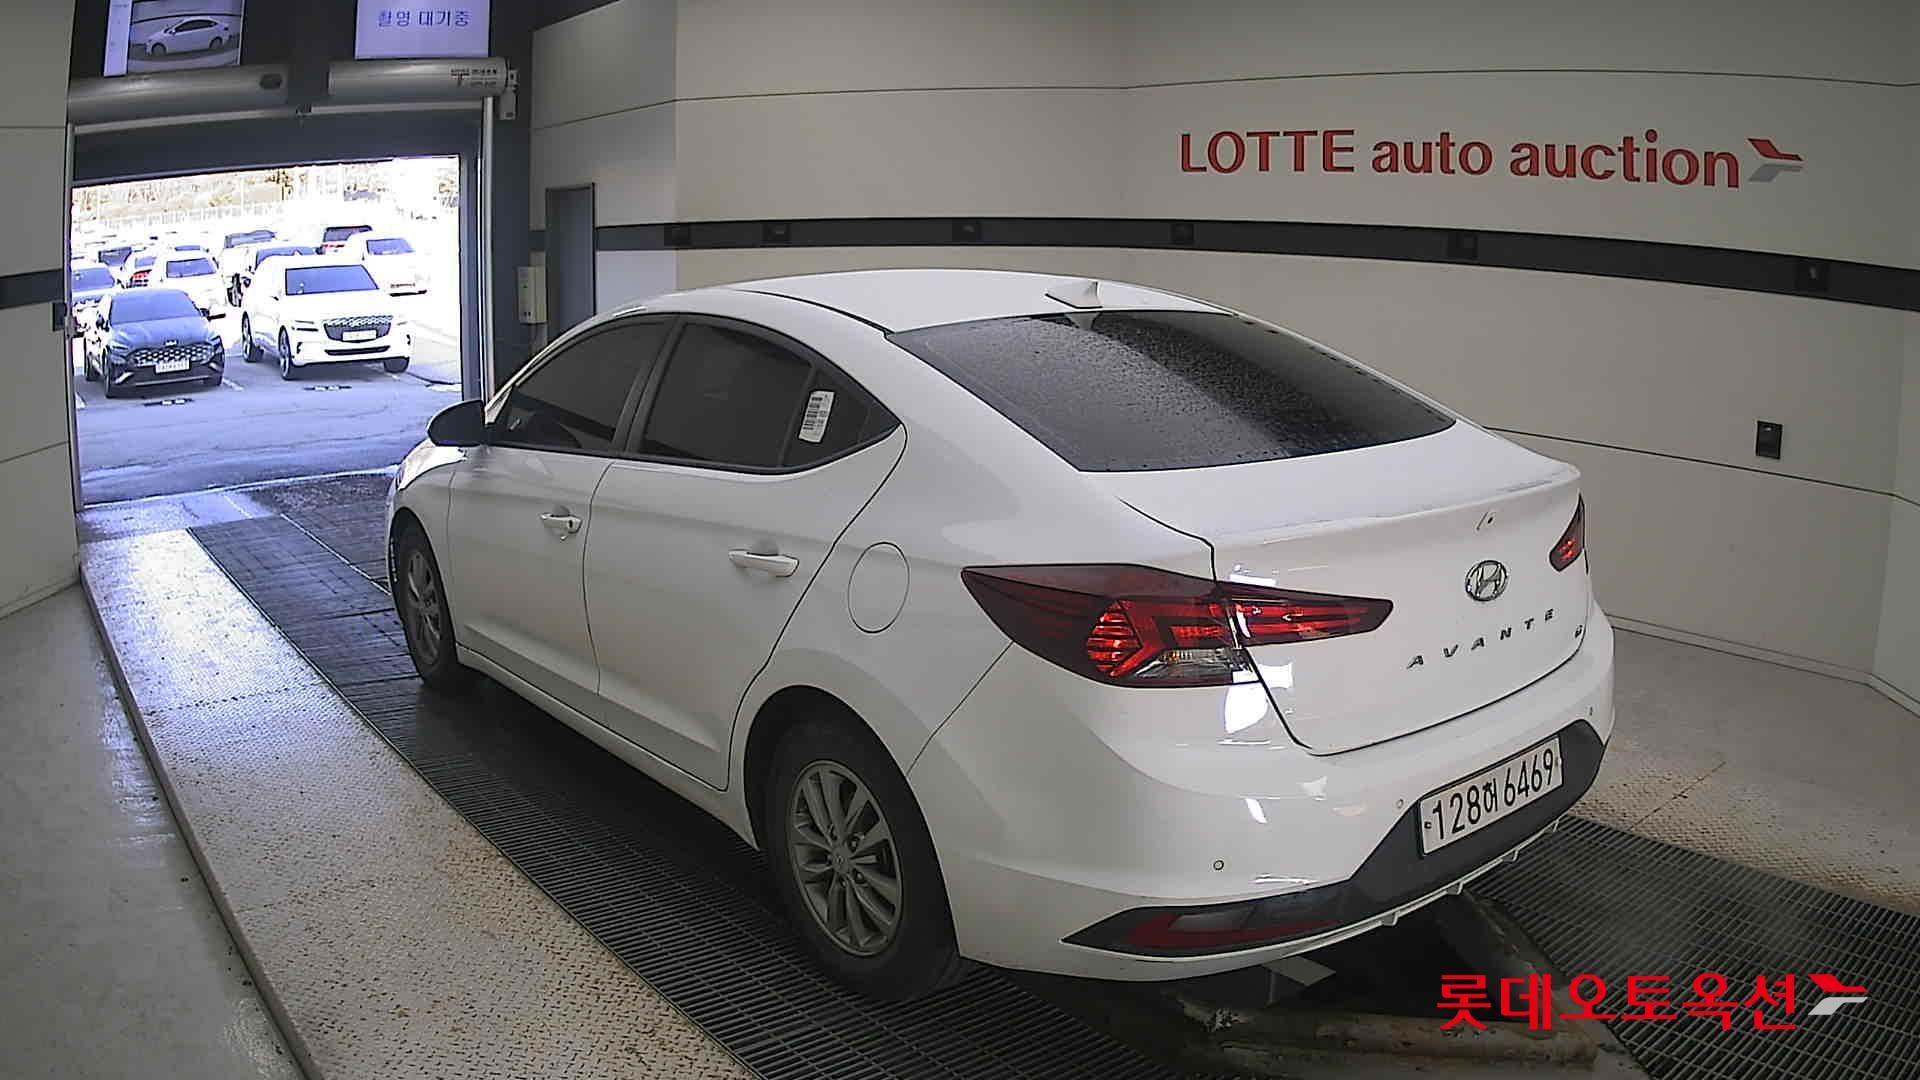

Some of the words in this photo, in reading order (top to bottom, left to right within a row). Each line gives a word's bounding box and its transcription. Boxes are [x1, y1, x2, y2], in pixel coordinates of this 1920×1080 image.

[418, 10, 469, 27] 대기중
[1181, 129, 1354, 174] LOTTE
[1371, 132, 1494, 175] auto
[1510, 129, 1740, 188] auction
[1407, 608, 1555, 670] AVANTE
